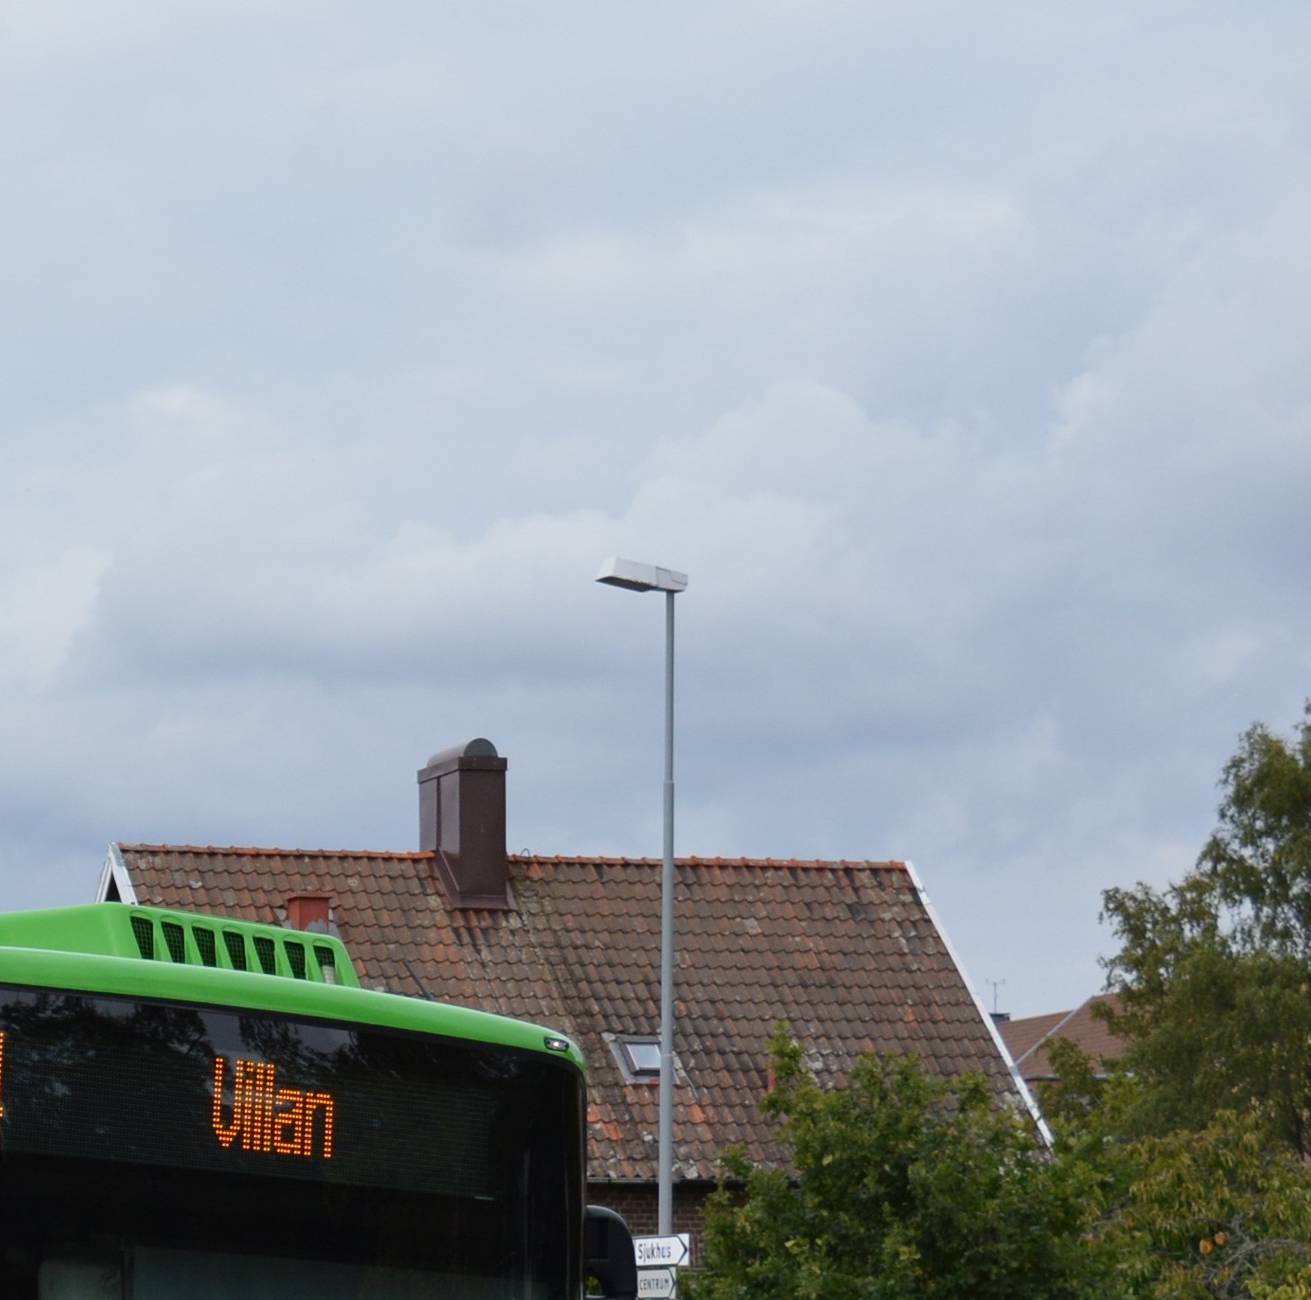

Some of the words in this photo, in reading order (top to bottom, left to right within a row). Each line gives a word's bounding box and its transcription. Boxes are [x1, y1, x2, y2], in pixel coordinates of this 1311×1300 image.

[212, 1057, 334, 1158] Villan
[638, 1243, 671, 1262] Sjukhus
[640, 1278, 670, 1291] CENTRUM
